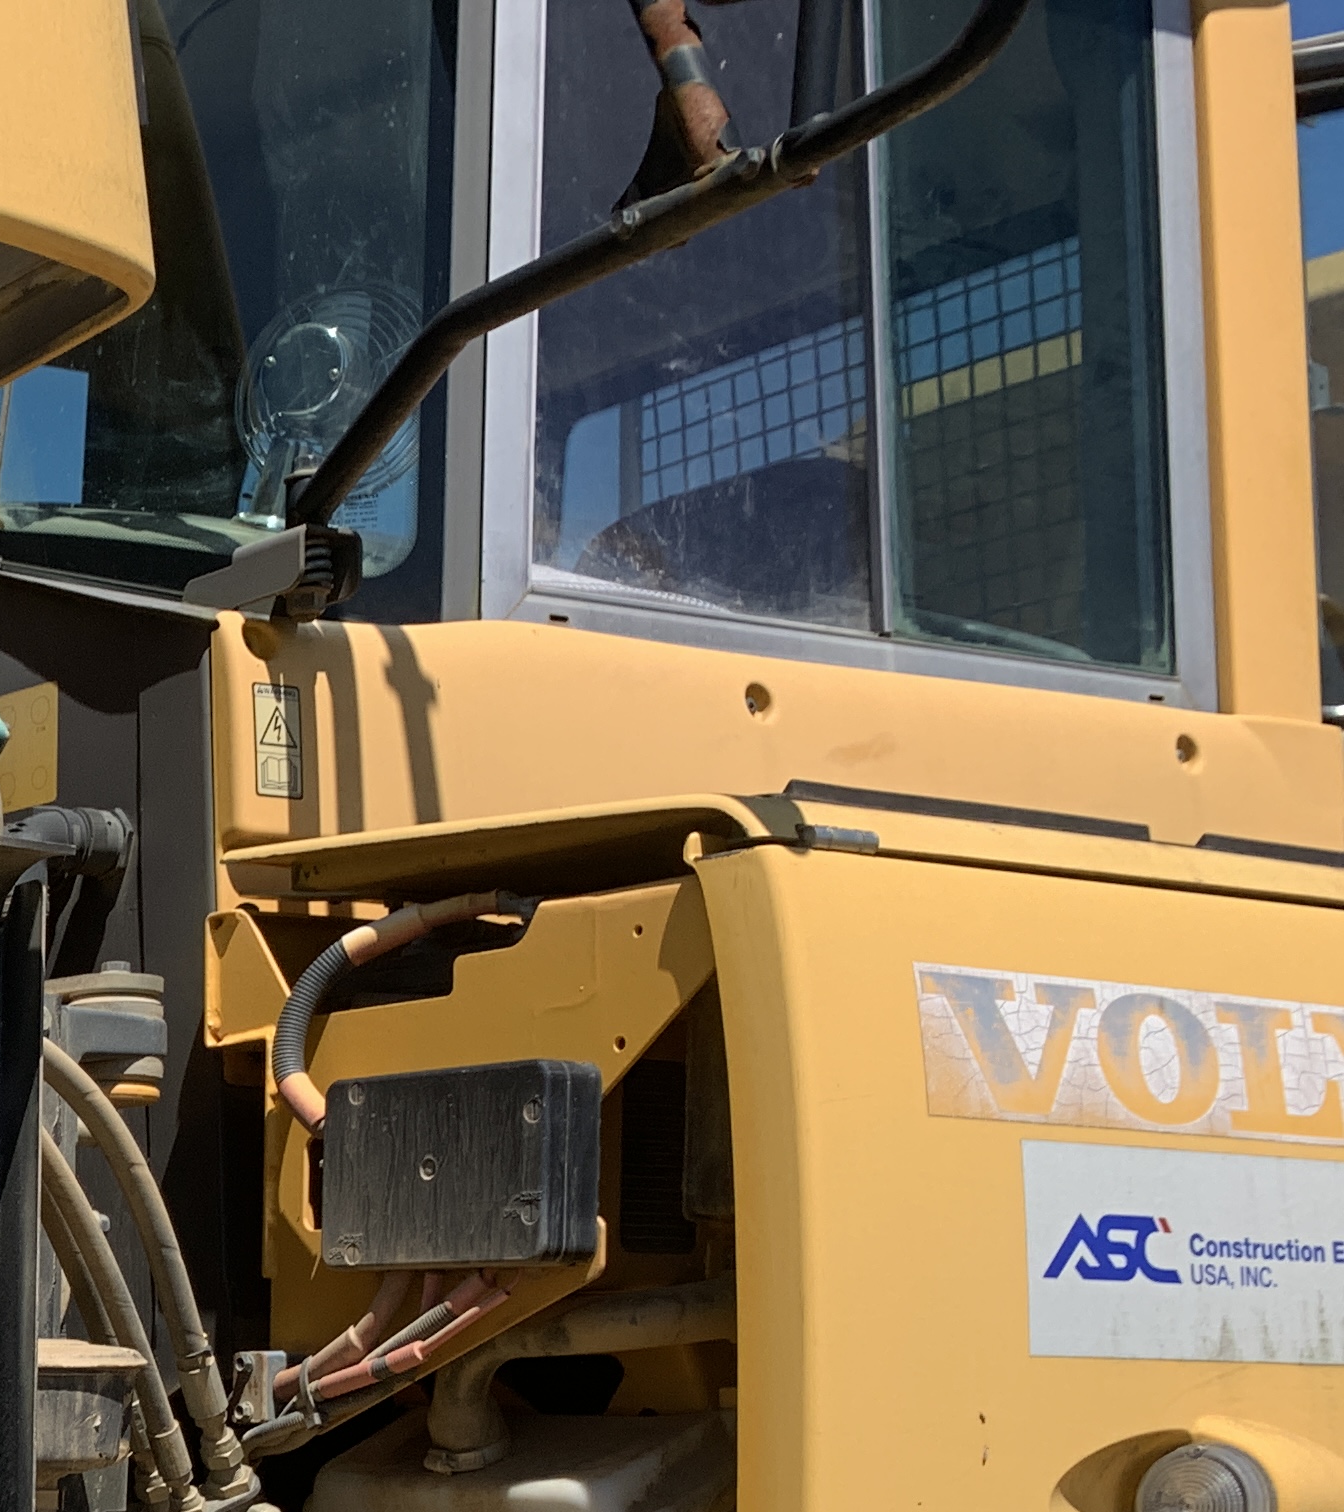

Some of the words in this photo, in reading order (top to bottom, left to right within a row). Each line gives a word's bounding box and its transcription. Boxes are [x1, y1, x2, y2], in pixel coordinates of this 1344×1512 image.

[920, 969, 1344, 1138] VOL
[1043, 1212, 1182, 1284] ASC
[1189, 1232, 1326, 1263] Construction
[1190, 1263, 1234, 1290] USA,
[1240, 1266, 1278, 1288] INC.
